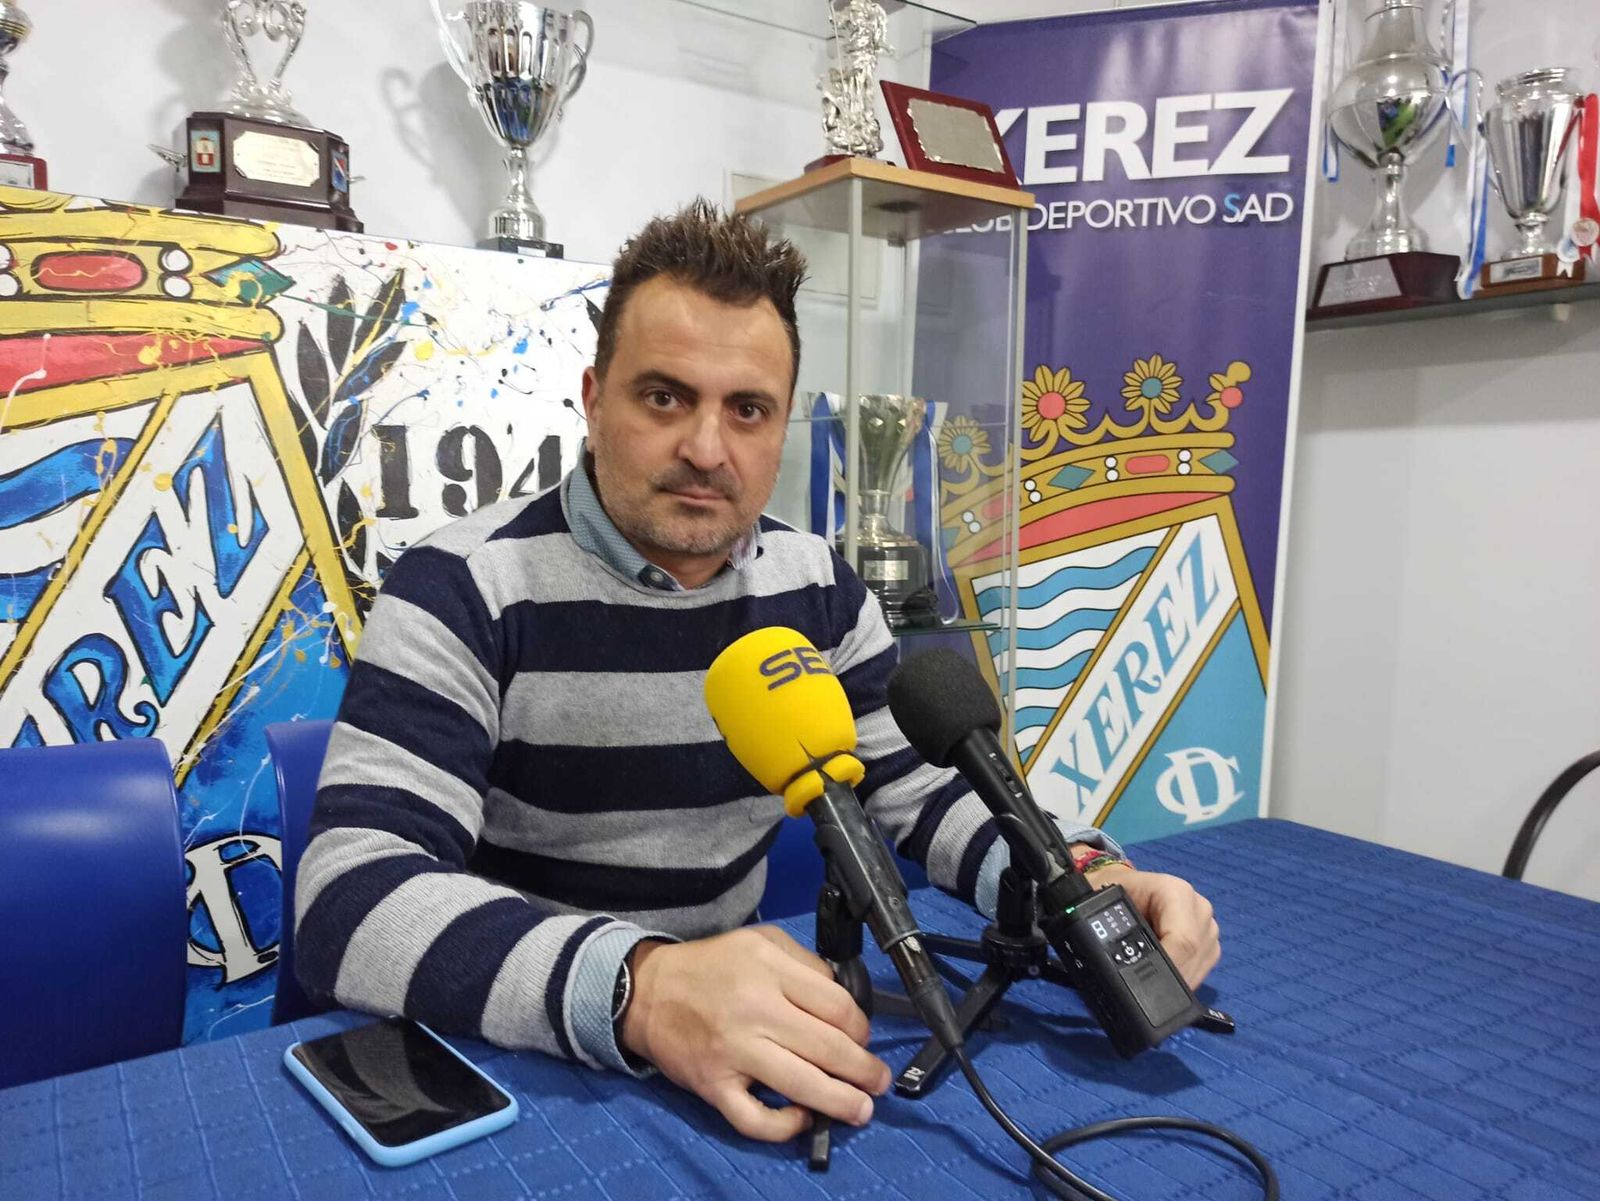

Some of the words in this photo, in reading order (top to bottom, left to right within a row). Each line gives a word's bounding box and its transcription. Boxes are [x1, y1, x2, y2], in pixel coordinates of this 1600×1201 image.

[1027, 194, 1216, 231] DEPORTIVO
[1222, 192, 1294, 224] SAD
[1050, 531, 1220, 815] XEREZ
